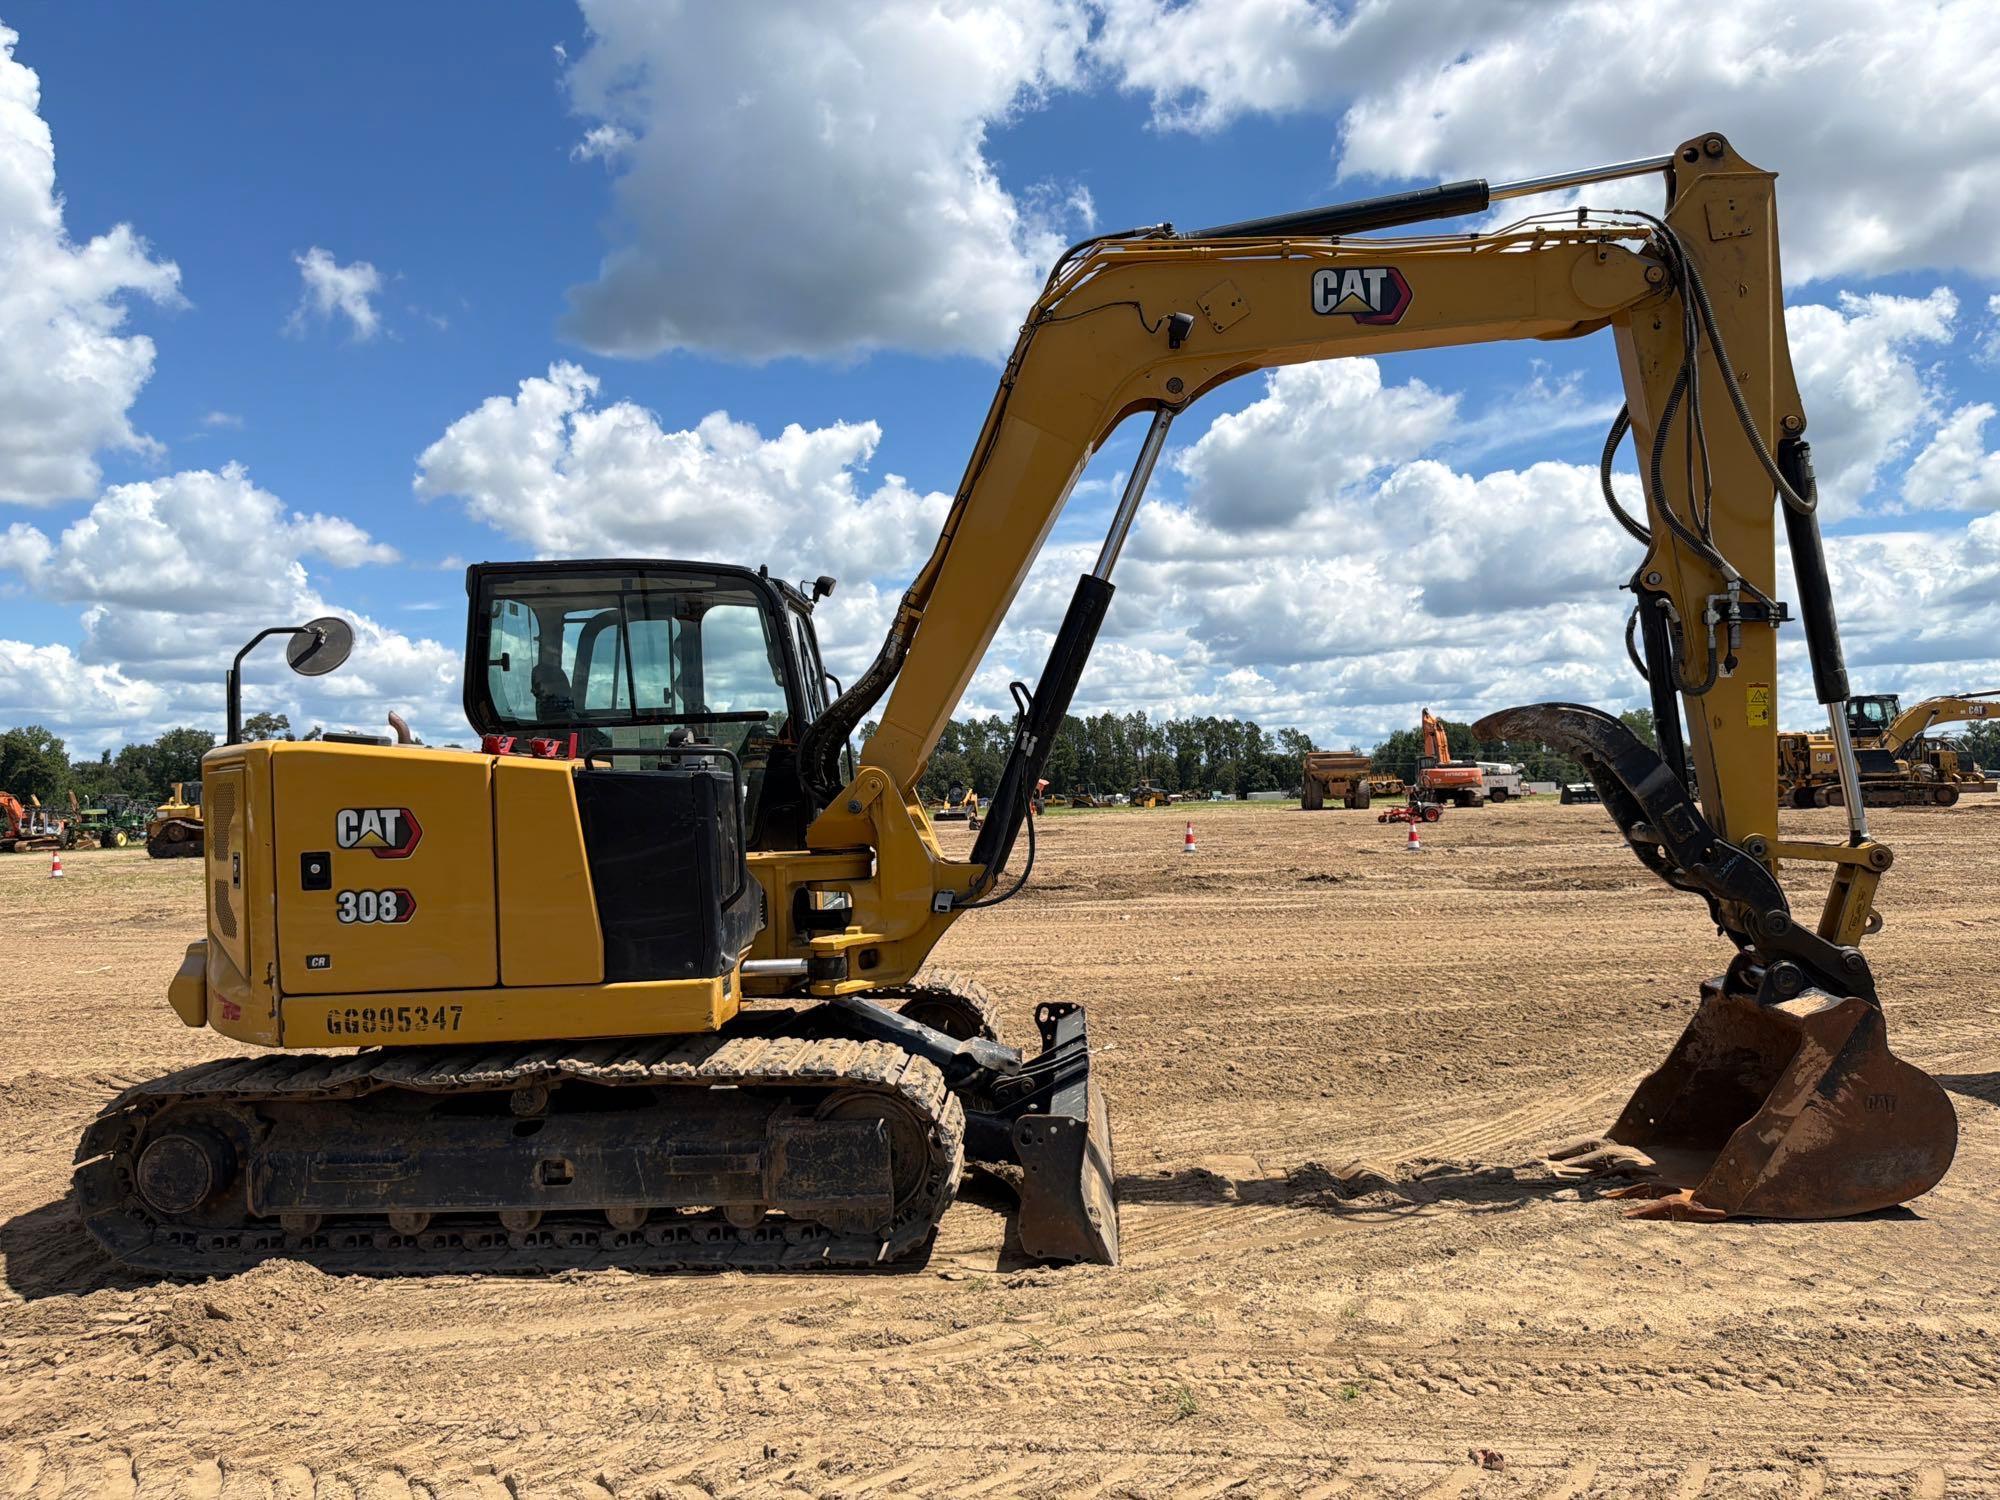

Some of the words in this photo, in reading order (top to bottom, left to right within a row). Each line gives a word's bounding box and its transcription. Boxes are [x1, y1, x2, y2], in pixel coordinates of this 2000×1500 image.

[1313, 268, 1387, 313] CAT
[1968, 705, 1984, 715] CAT
[1816, 752, 1831, 762] CAT
[337, 809, 401, 848] CAT
[338, 891, 397, 922] 308
[311, 957, 326, 967] CR
